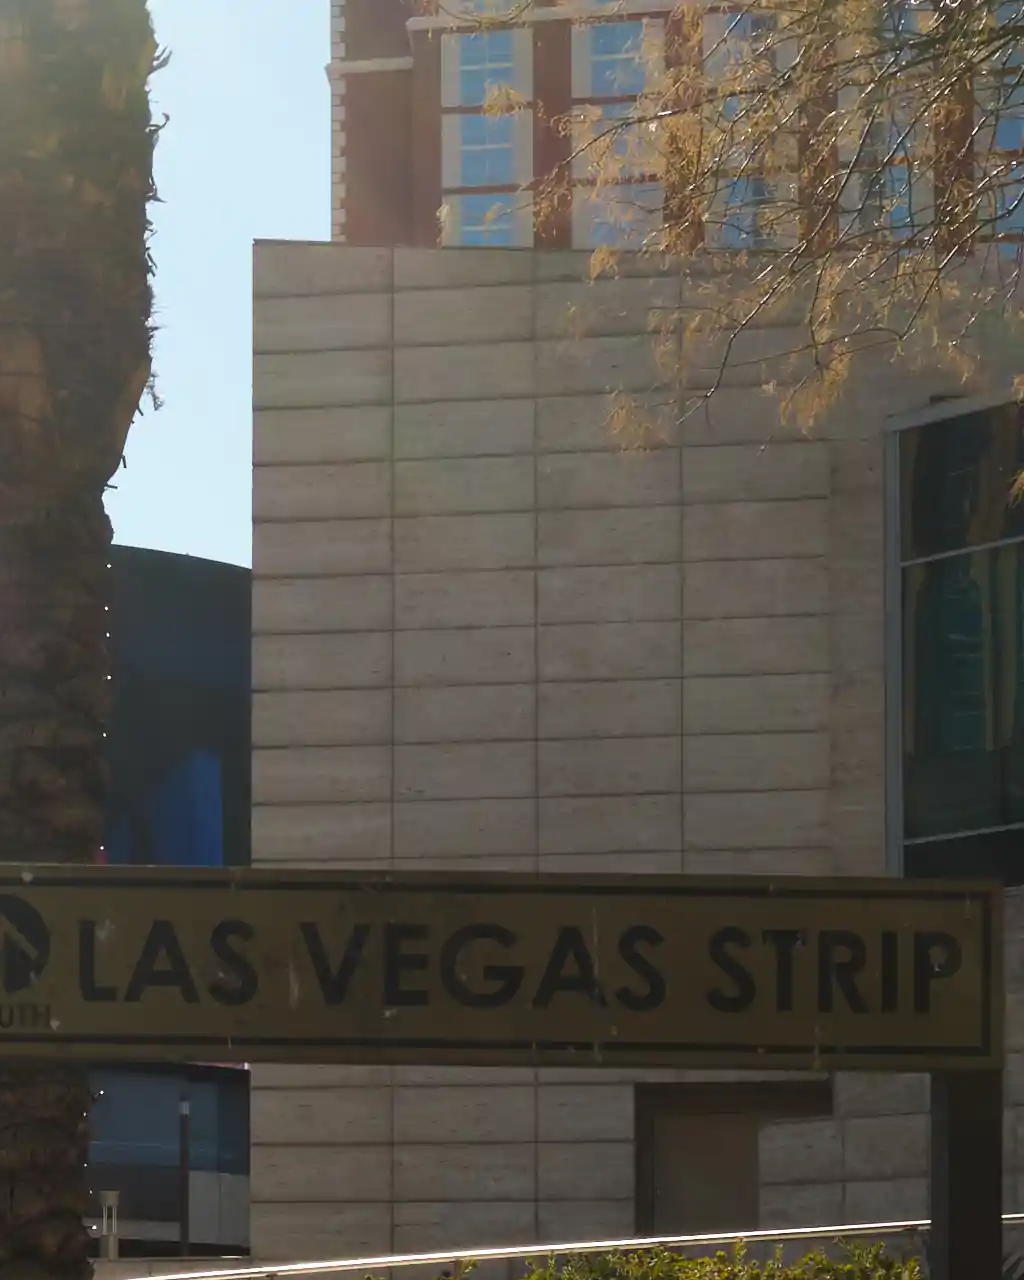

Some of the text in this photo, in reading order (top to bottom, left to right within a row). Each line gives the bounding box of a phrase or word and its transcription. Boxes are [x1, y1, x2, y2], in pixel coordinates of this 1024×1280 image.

[77, 919, 966, 1017] LAS VEGAS STRIP
